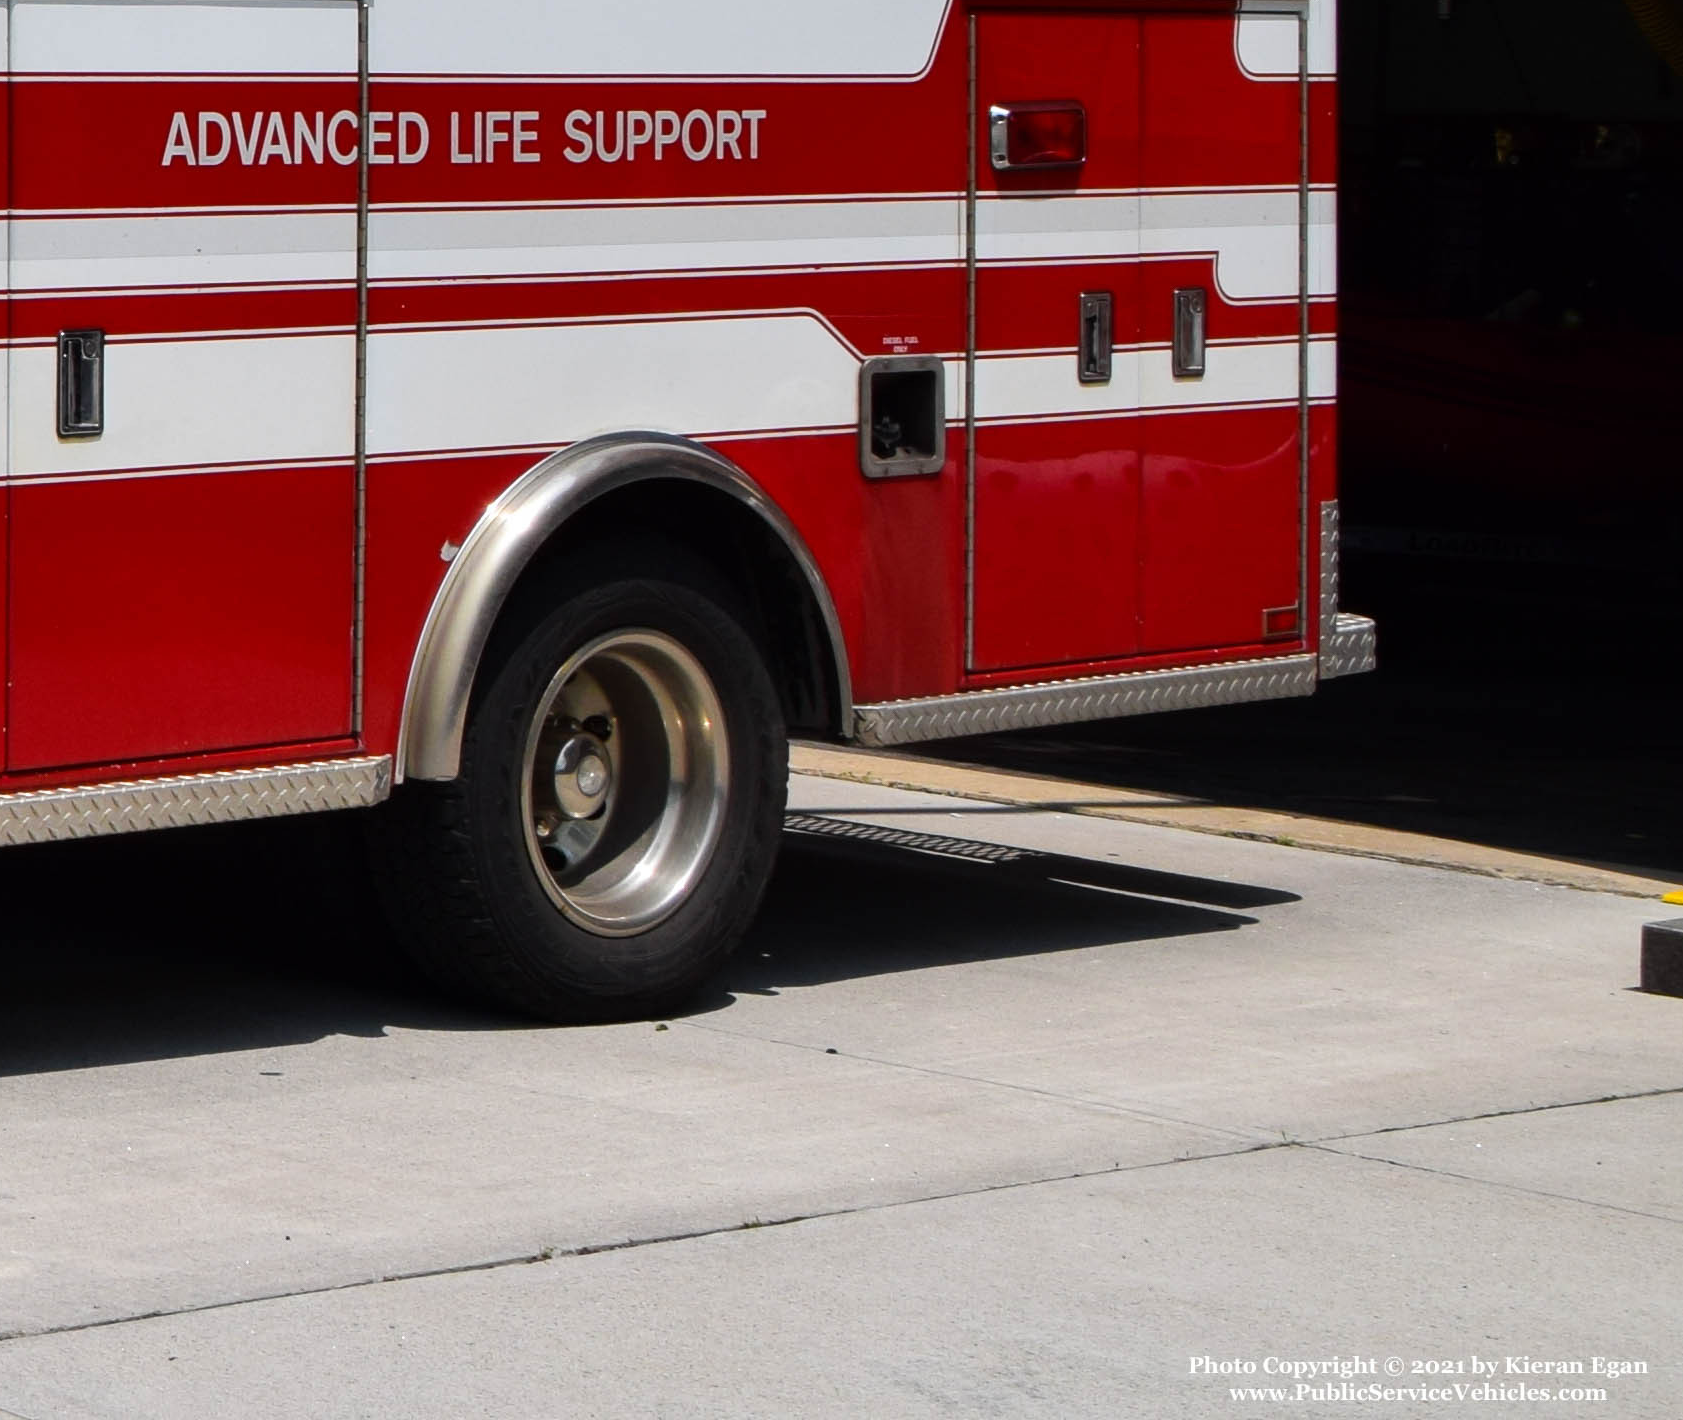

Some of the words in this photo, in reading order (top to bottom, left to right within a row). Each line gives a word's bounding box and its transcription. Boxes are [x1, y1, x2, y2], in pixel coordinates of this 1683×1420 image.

[161, 110, 429, 166] ADVANCED
[450, 110, 540, 165] LIFE
[563, 108, 767, 164] SUPPORT
